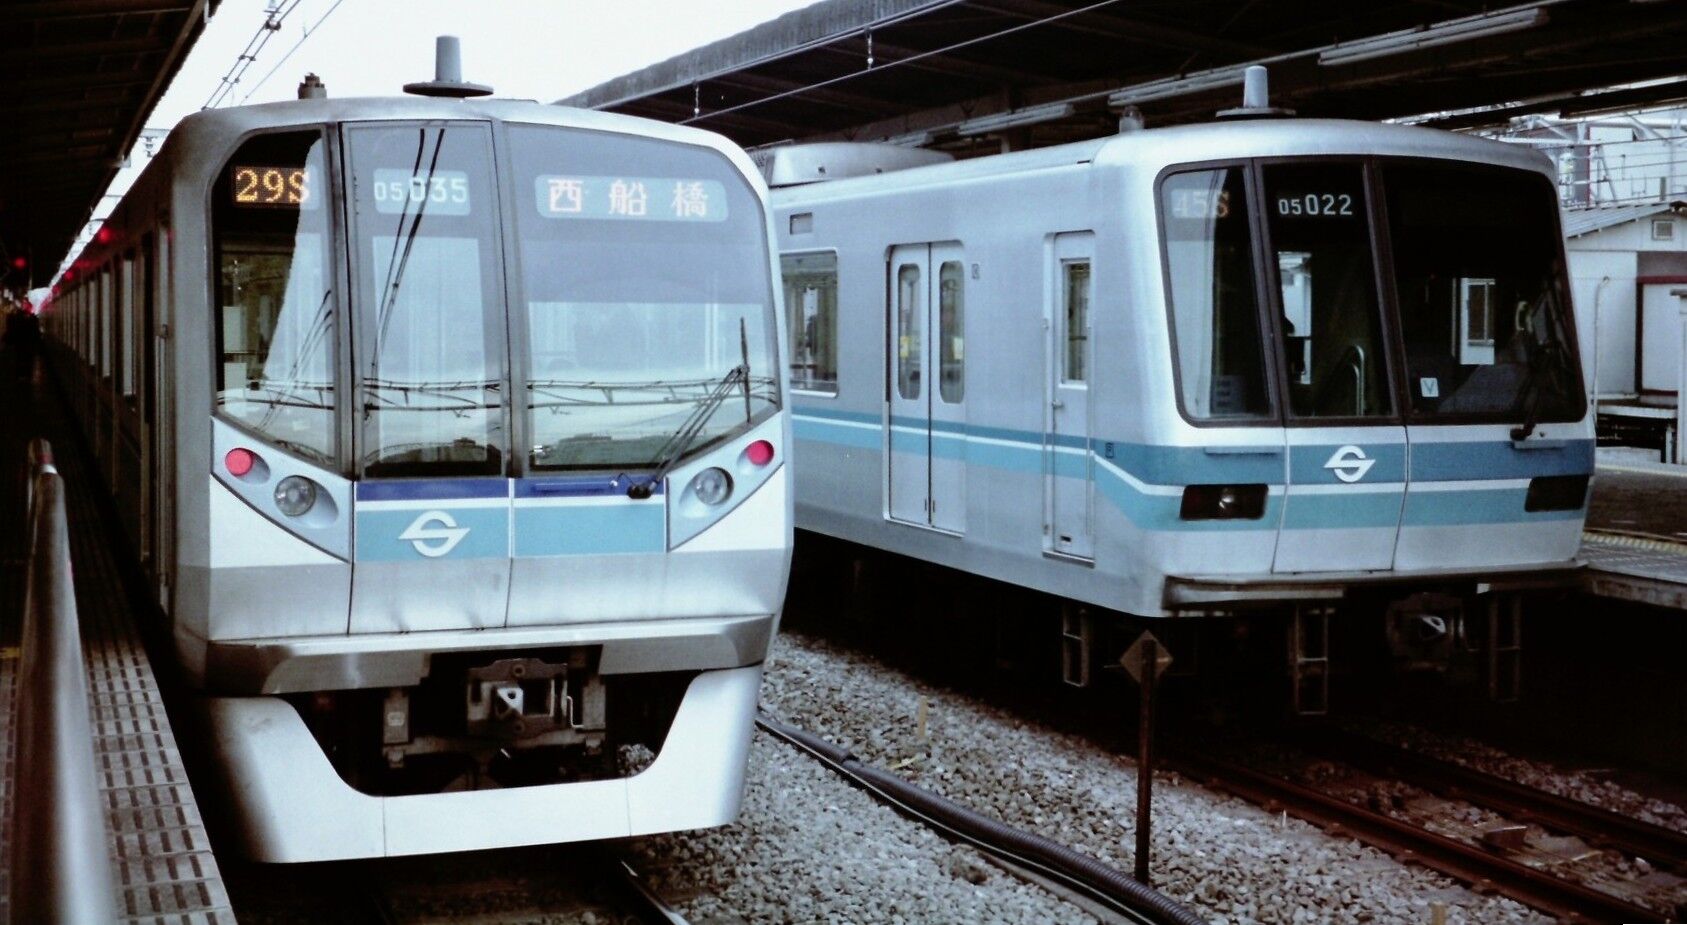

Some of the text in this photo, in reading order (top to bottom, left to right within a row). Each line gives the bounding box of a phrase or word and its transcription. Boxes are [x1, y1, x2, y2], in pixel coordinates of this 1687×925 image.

[236, 169, 309, 203] 29S
[374, 176, 468, 203] 05035
[547, 178, 708, 218] 西船橋
[1278, 194, 1353, 215] 05022
